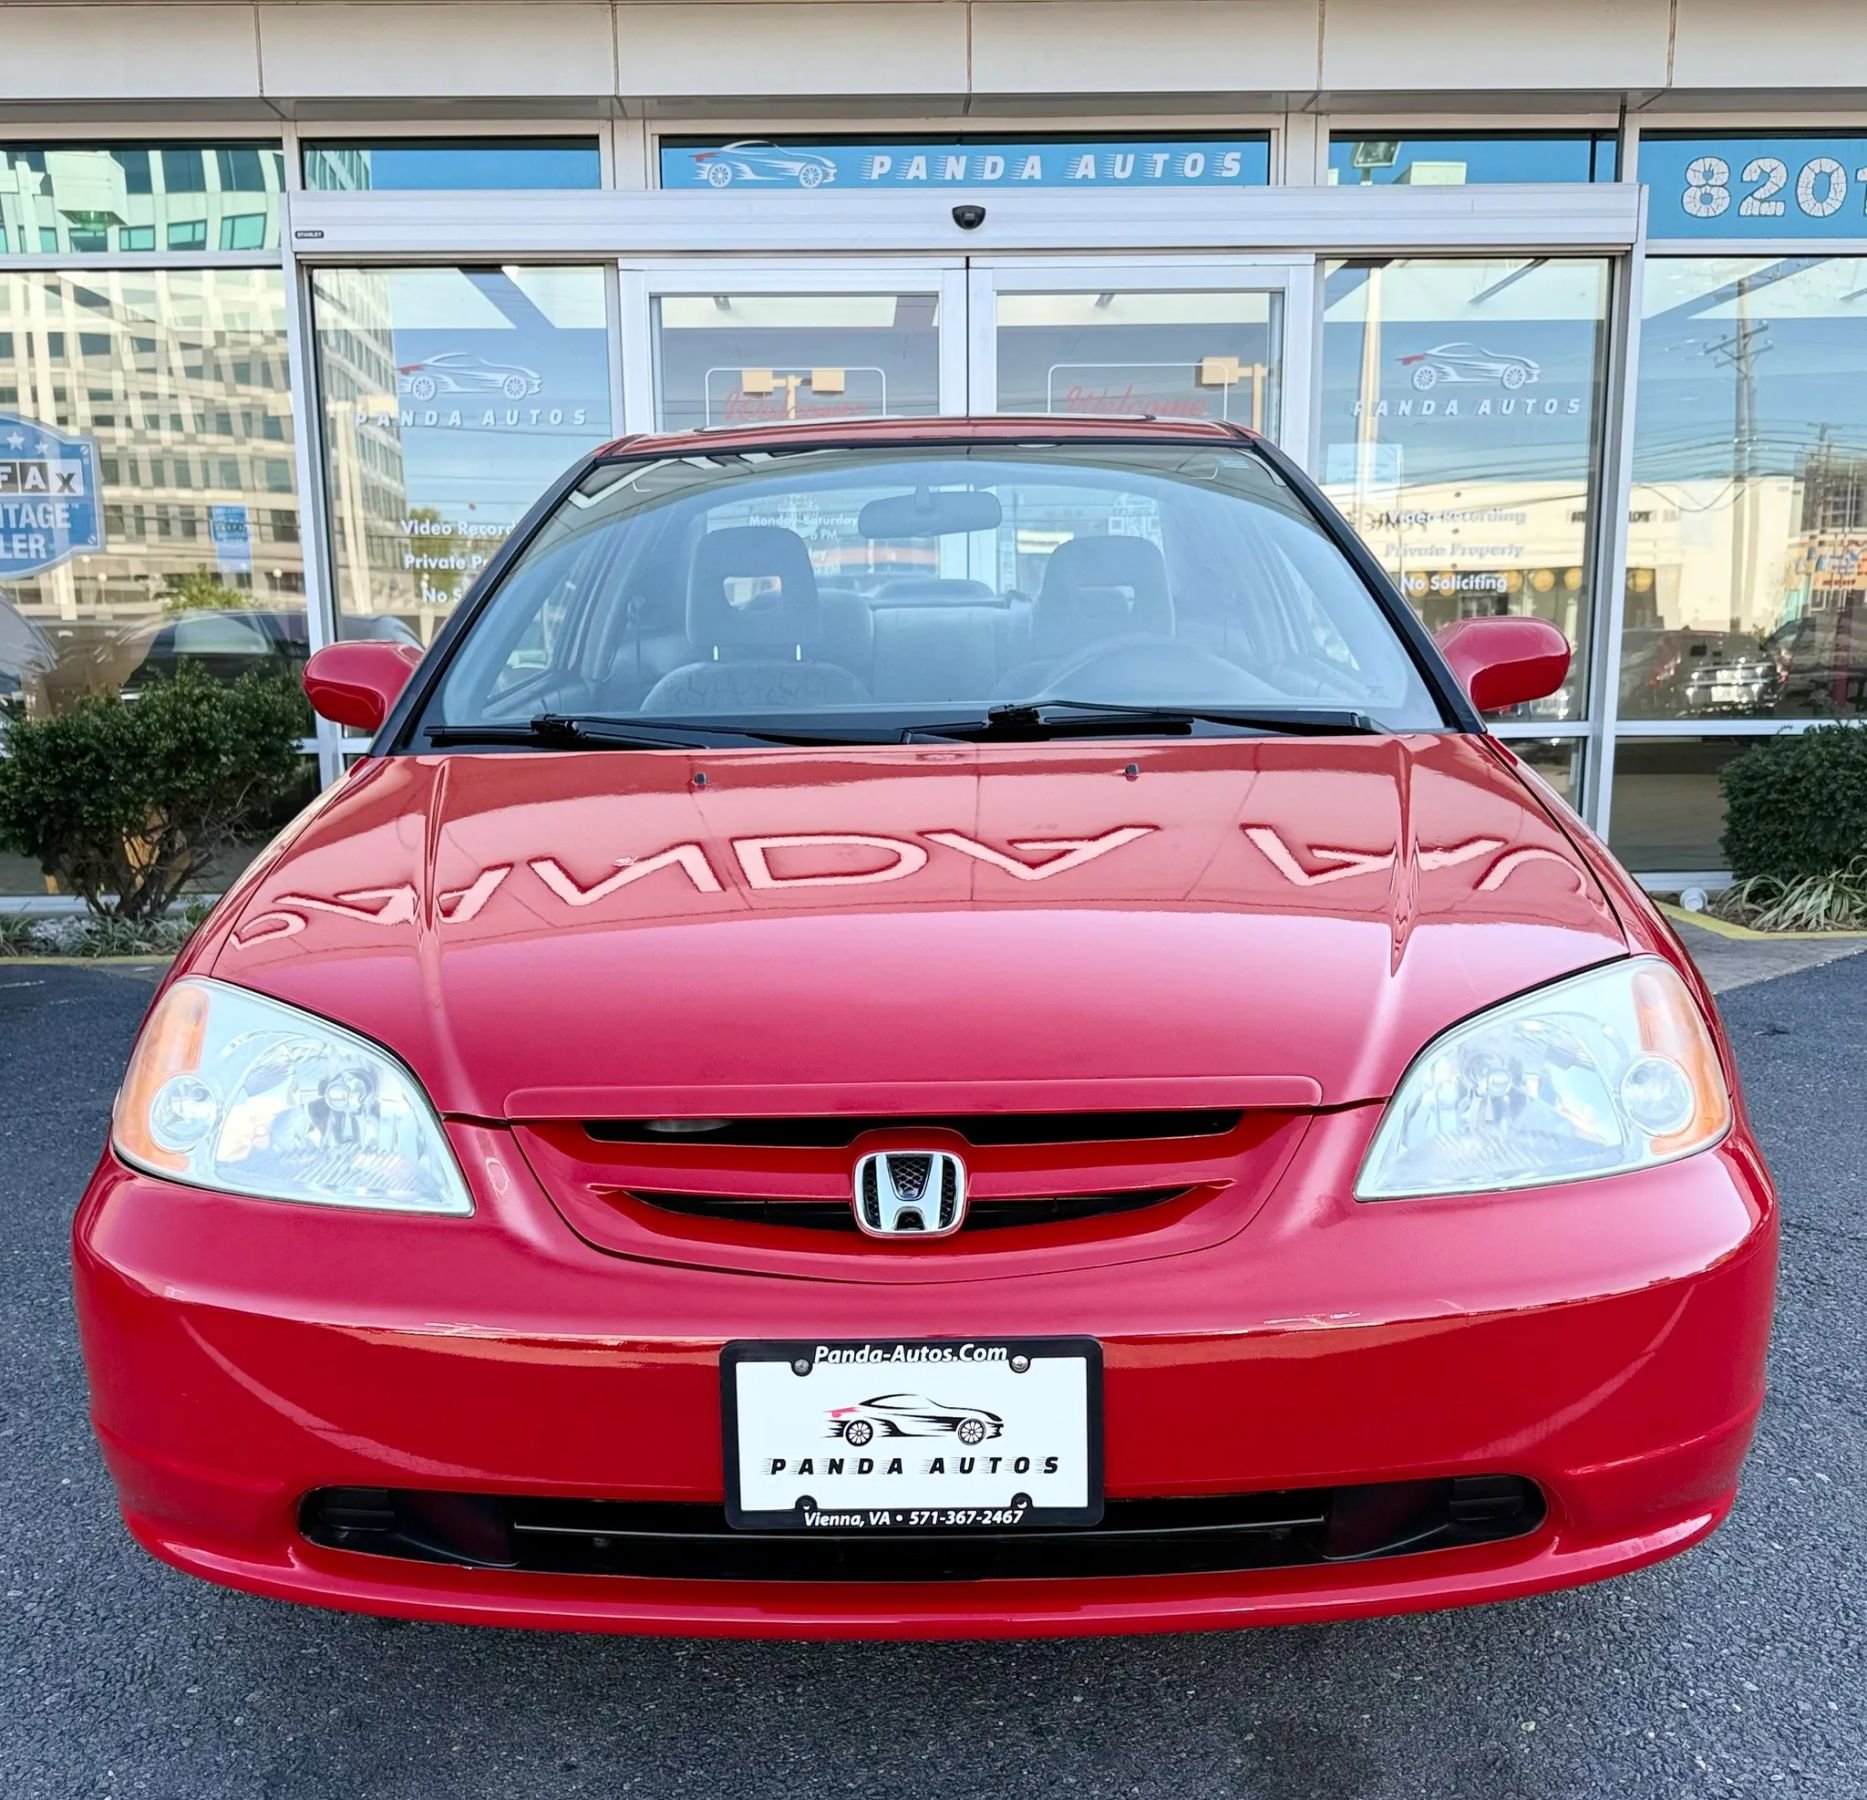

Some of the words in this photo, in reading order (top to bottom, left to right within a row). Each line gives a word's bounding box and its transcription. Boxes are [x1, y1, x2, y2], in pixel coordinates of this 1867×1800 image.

[860, 154, 1043, 180] PANDA
[1066, 151, 1242, 179] AUTOS
[1352, 400, 1459, 416] PANDA
[1477, 398, 1581, 415] AUTOS
[355, 410, 464, 426] PANDA
[482, 408, 586, 426] AUTOS
[1442, 510, 1526, 525] Recording
[400, 519, 452, 535] Video
[1386, 544, 1447, 557] Private
[1450, 543, 1524, 558] Property
[404, 553, 466, 569] Private
[1402, 575, 1425, 590] No
[1430, 575, 1508, 593] Soliciting
[422, 588, 448, 602] No
[814, 1344, 1008, 1364] Panda-Autos.Com
[766, 1458, 903, 1475] PANDA
[926, 1456, 1058, 1475] AUTOS
[804, 1511, 865, 1528] Vienna,
[868, 1511, 891, 1526] VA
[909, 1510, 1024, 1526] 571-367-2467
